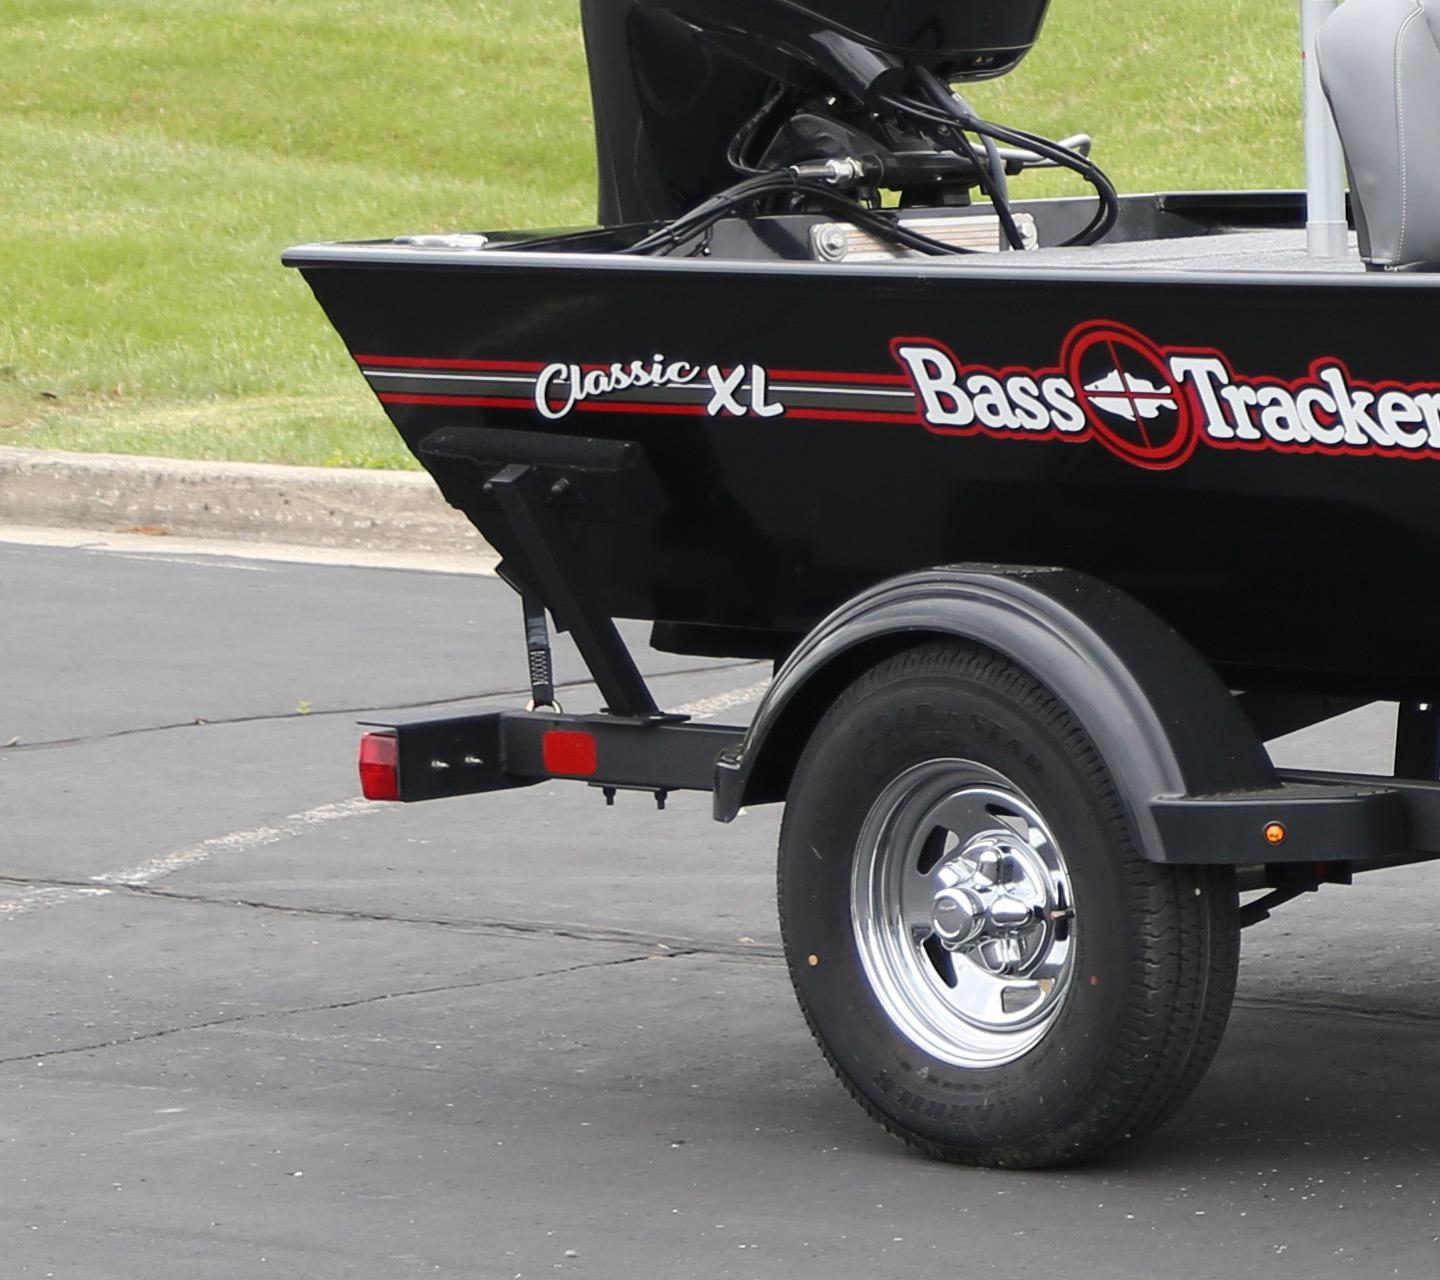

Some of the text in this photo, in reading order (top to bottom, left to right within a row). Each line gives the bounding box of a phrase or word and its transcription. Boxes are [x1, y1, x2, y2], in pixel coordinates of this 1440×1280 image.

[535, 352, 785, 420] Classic XL
[896, 346, 1088, 432] Bass
